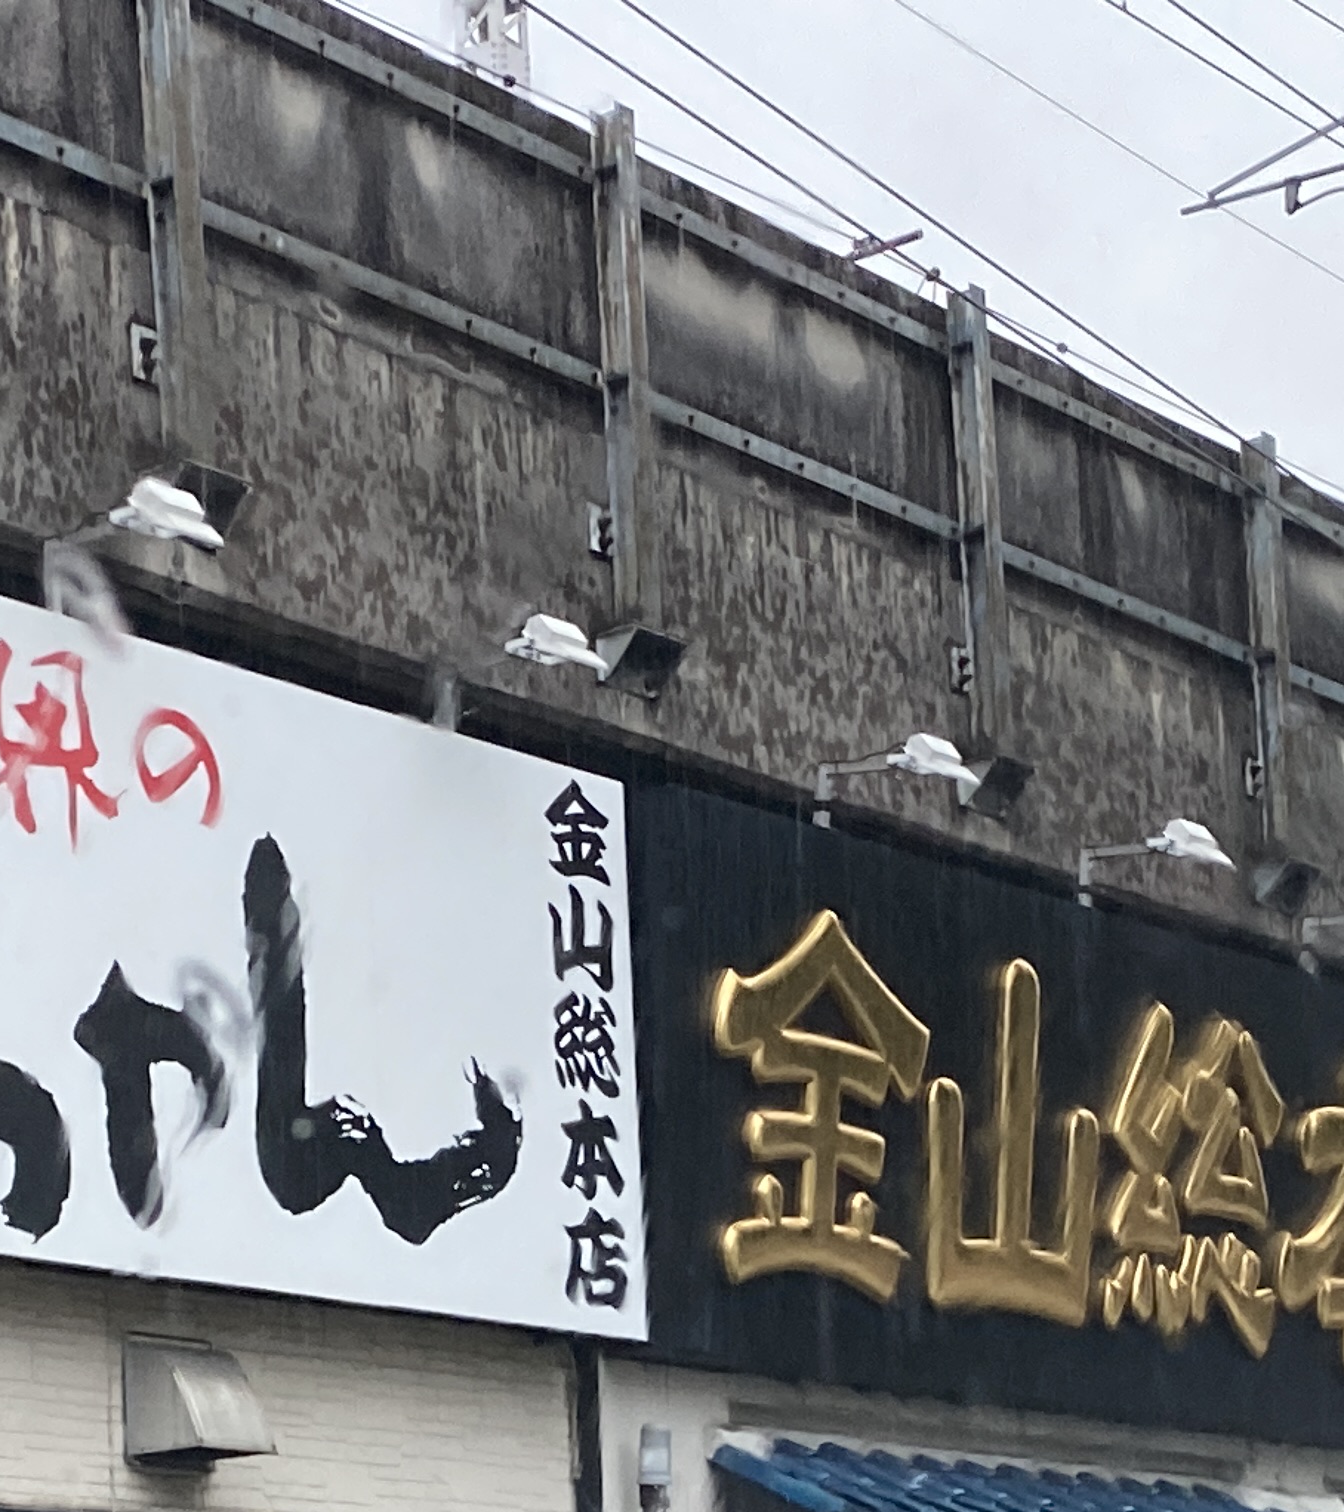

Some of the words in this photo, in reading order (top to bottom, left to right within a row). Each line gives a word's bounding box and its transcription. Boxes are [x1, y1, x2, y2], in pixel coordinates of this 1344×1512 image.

[544, 778, 629, 1311] 金山総本店
